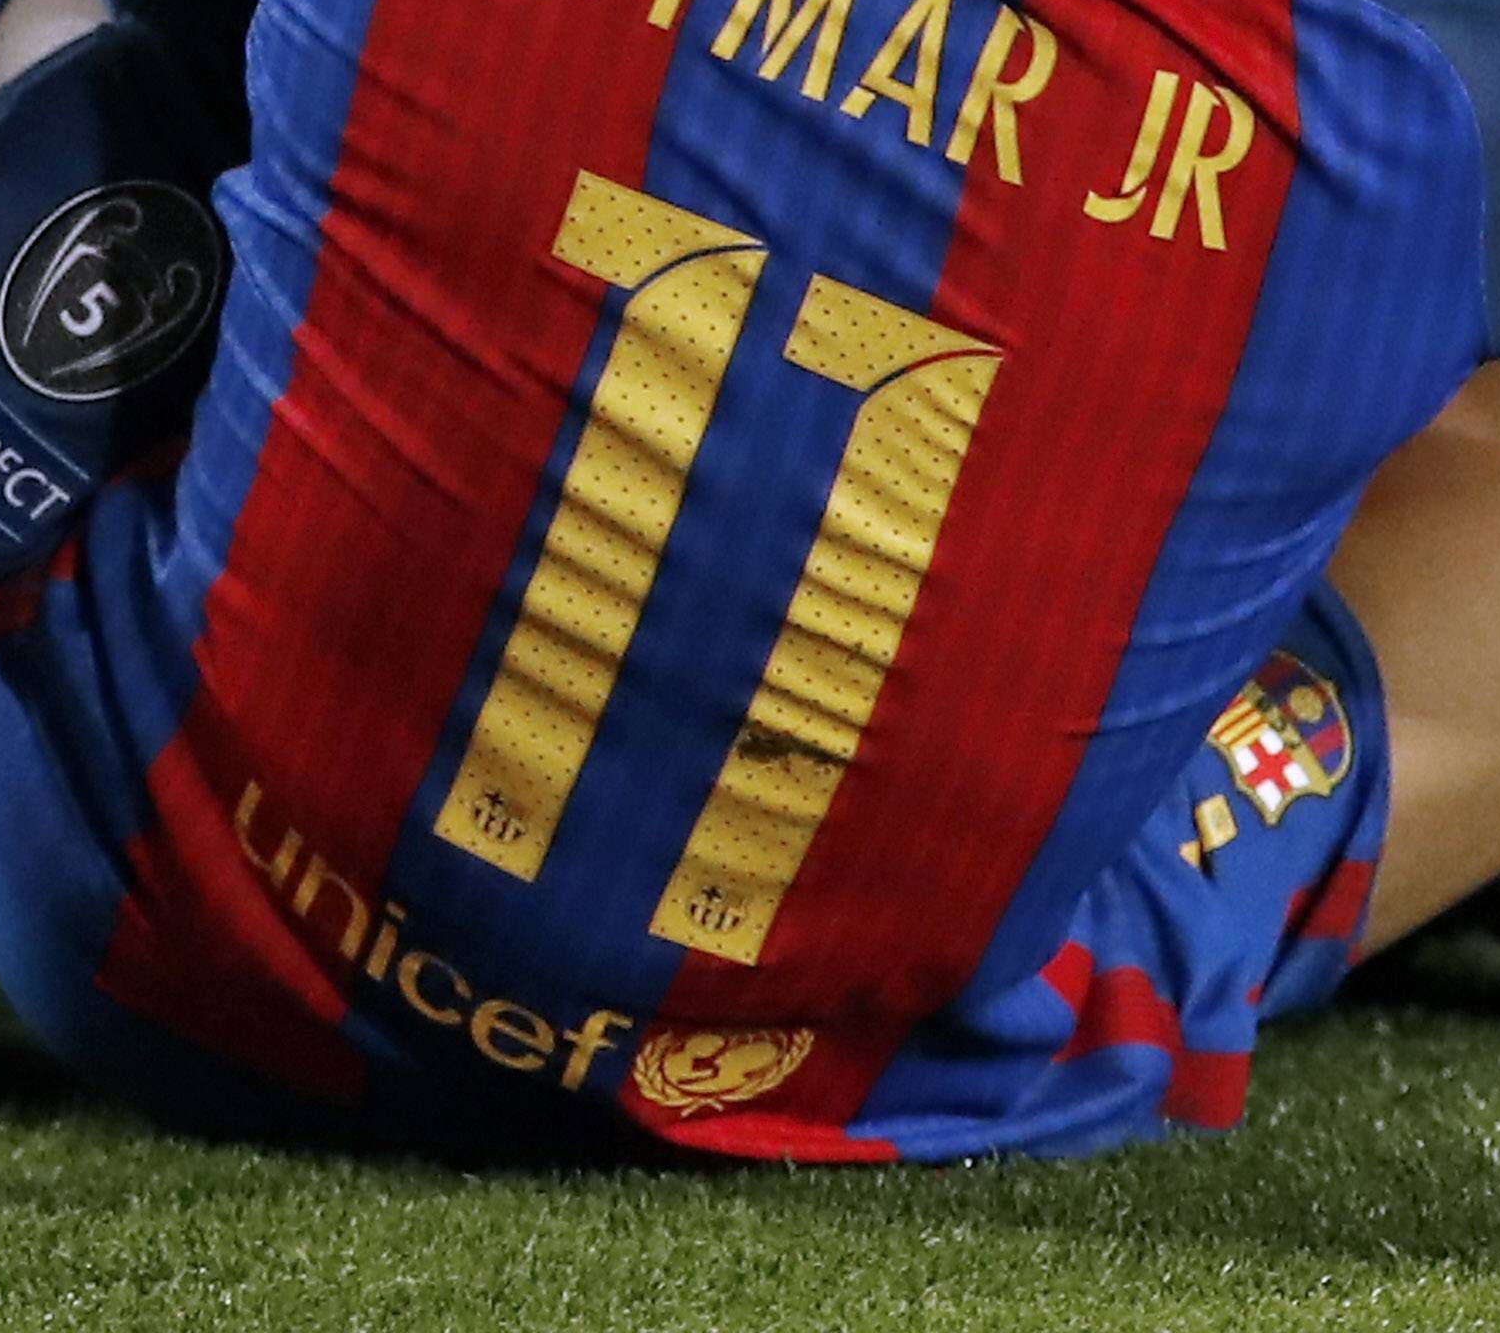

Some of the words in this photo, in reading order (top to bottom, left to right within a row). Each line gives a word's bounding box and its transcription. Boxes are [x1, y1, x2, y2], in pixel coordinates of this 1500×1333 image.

[1083, 69, 1256, 251] JR
[58, 281, 120, 336] 5
[432, 170, 1004, 967] 11
[233, 779, 634, 1092] unicef
